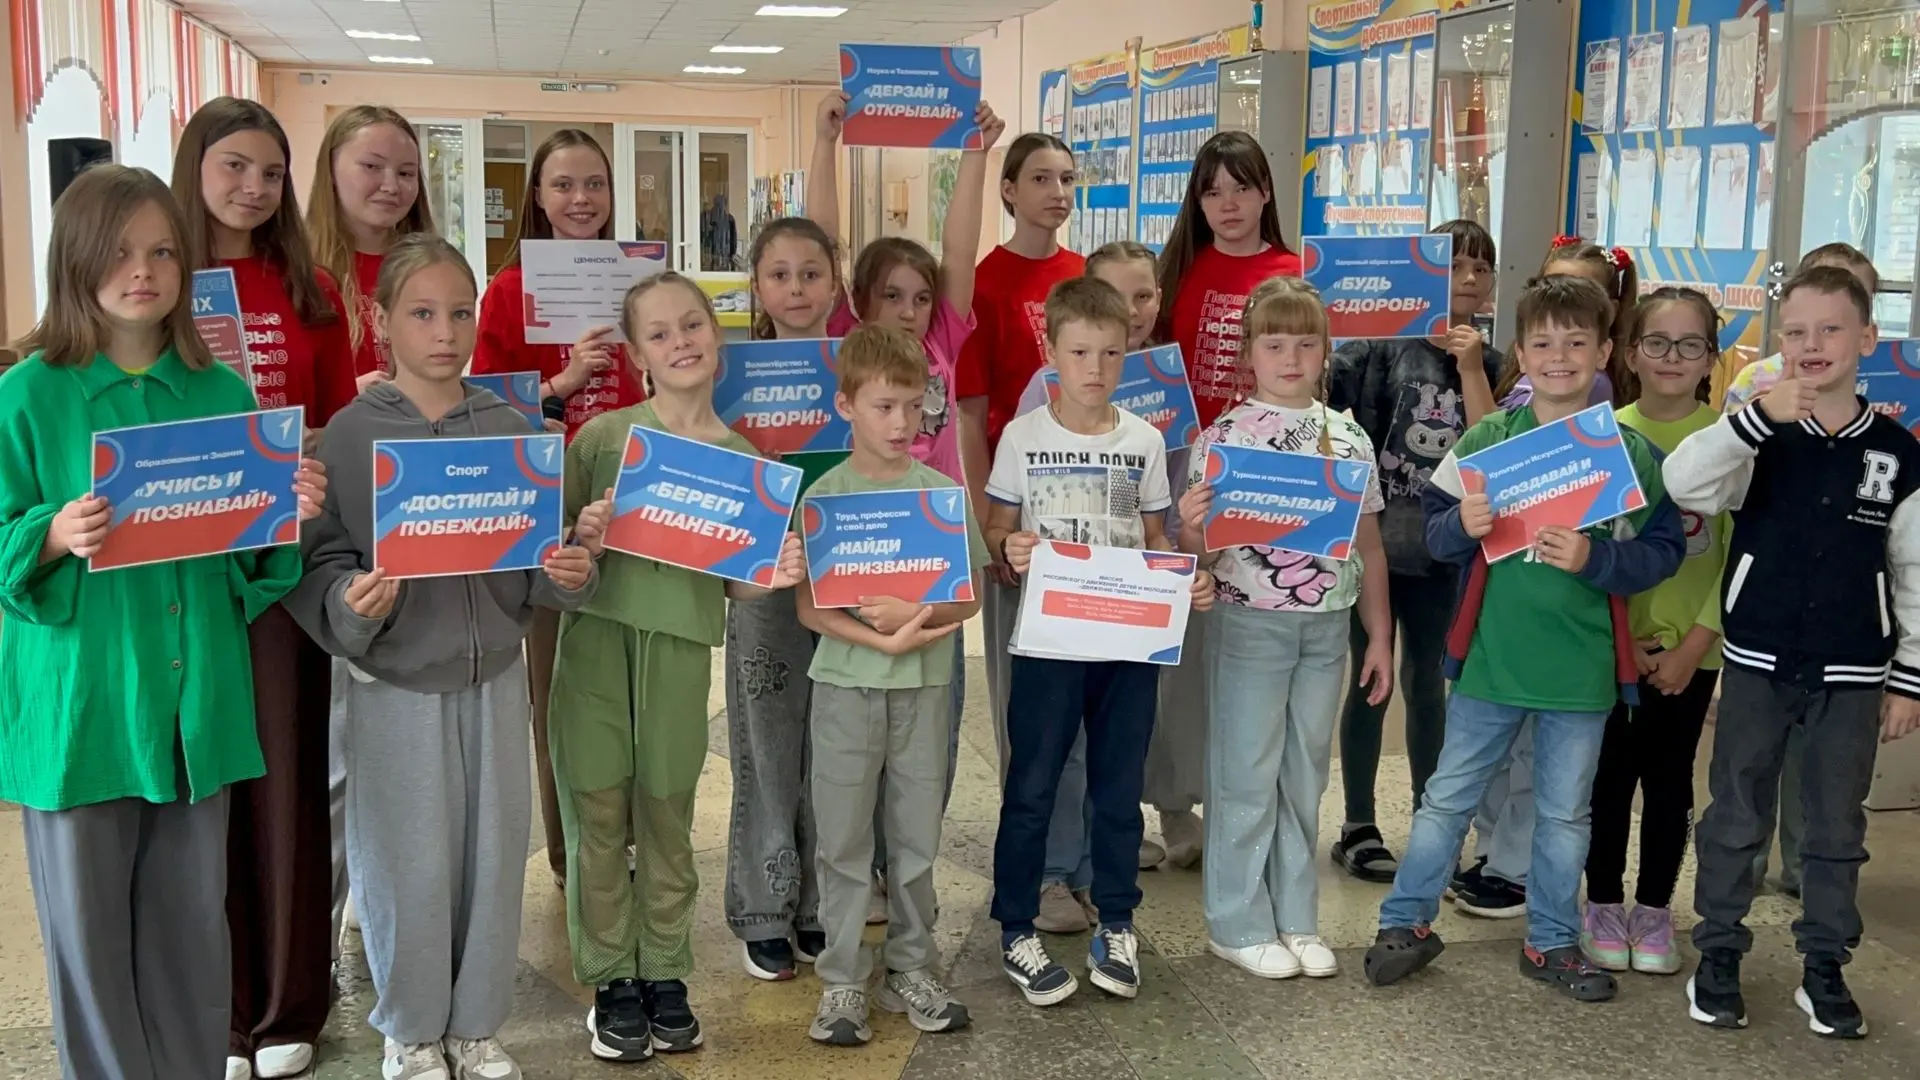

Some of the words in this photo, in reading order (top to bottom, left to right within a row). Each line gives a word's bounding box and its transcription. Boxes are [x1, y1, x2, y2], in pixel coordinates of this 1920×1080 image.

[864, 84, 934, 99] «ДЕРЗАЙ
[937, 87, 949, 100] И
[864, 103, 963, 120] ОТКРЫВАЙ!»
[1333, 276, 1392, 292] «БУДЬ
[1332, 297, 1431, 314] ЗДОРОВ!»
[743, 384, 822, 402] «БЛАГО
[744, 409, 832, 428] ТВОРИ!»
[135, 453, 200, 469] Образование
[210, 449, 245, 460] Знания
[445, 465, 489, 478] Спорт
[1494, 460, 1578, 503] «СОЗДАВАЙ
[1579, 458, 1592, 471] И
[1857, 449, 1899, 503] R
[134, 473, 222, 498] «УЧИСЬ
[227, 470, 243, 488] И
[1499, 470, 1612, 518] ВДОХНОВЛЯЙ!»
[133, 488, 276, 525] ПОЗНАВАЙ!»
[400, 487, 519, 515] «ДОСТИГАЙ
[521, 489, 537, 506] И
[647, 481, 745, 517] «БЕРЕГИ
[1220, 490, 1338, 513] «ОТКРЫВАЙ
[400, 511, 536, 537] ПОБЕЖДАЙ!»
[640, 504, 757, 546] ПЛАНЕТУ!»
[835, 512, 859, 523] Труд,
[860, 510, 911, 521] профессии
[1223, 507, 1310, 527] СТРАНУ!»
[832, 537, 901, 556] «НАЙДИ
[834, 557, 951, 576] ПРИЗВАНИЕ»
